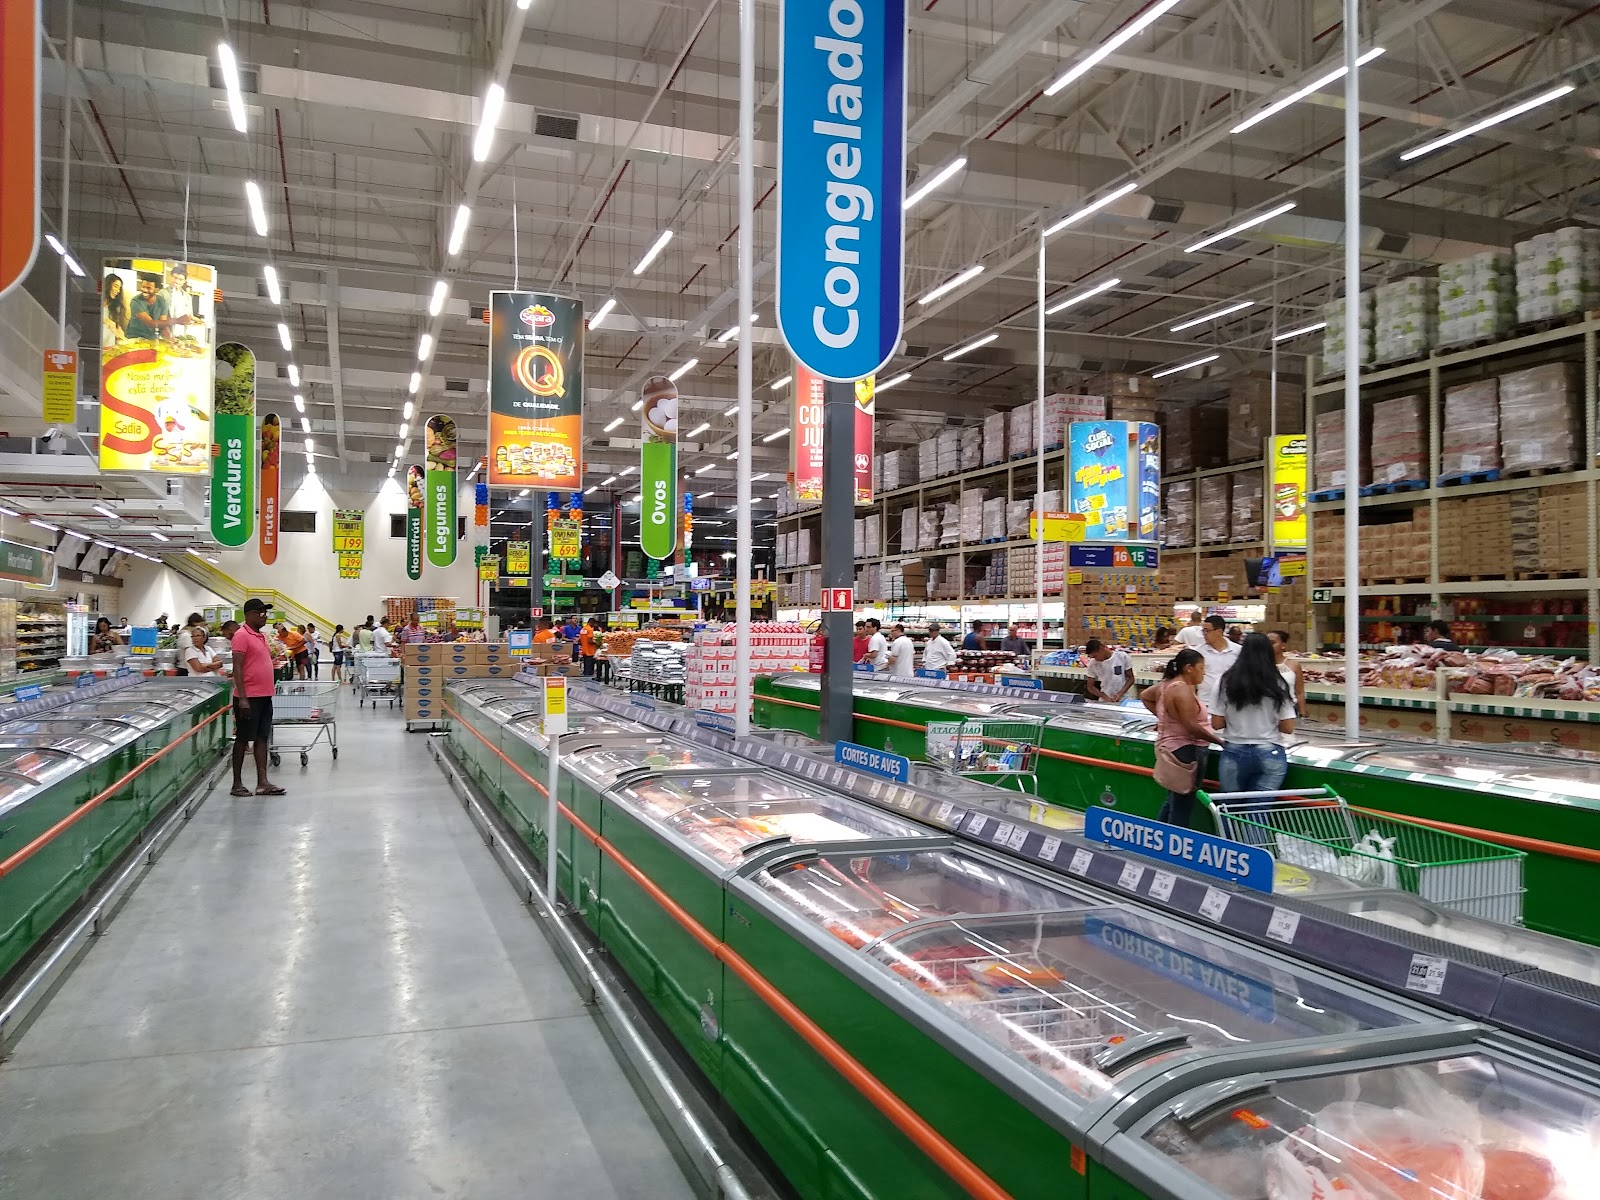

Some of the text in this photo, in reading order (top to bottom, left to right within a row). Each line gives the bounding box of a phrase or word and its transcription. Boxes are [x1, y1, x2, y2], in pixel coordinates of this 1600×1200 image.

[522, 312, 552, 323] Seara
[516, 345, 566, 398] Q
[114, 420, 142, 435] Sadia
[1088, 430, 1108, 443] CLUB
[222, 438, 242, 529] Verduras
[651, 480, 667, 525] Ovos
[264, 496, 274, 545] Frutas
[434, 485, 450, 553] Legumes
[411, 518, 420, 573] Hortifrúti
[1114, 551, 1128, 562] 16
[1131, 551, 1145, 562] 15
[841, 746, 901, 776] CORTES DE AVES
[1101, 816, 1250, 877] CORTES DE AVES
